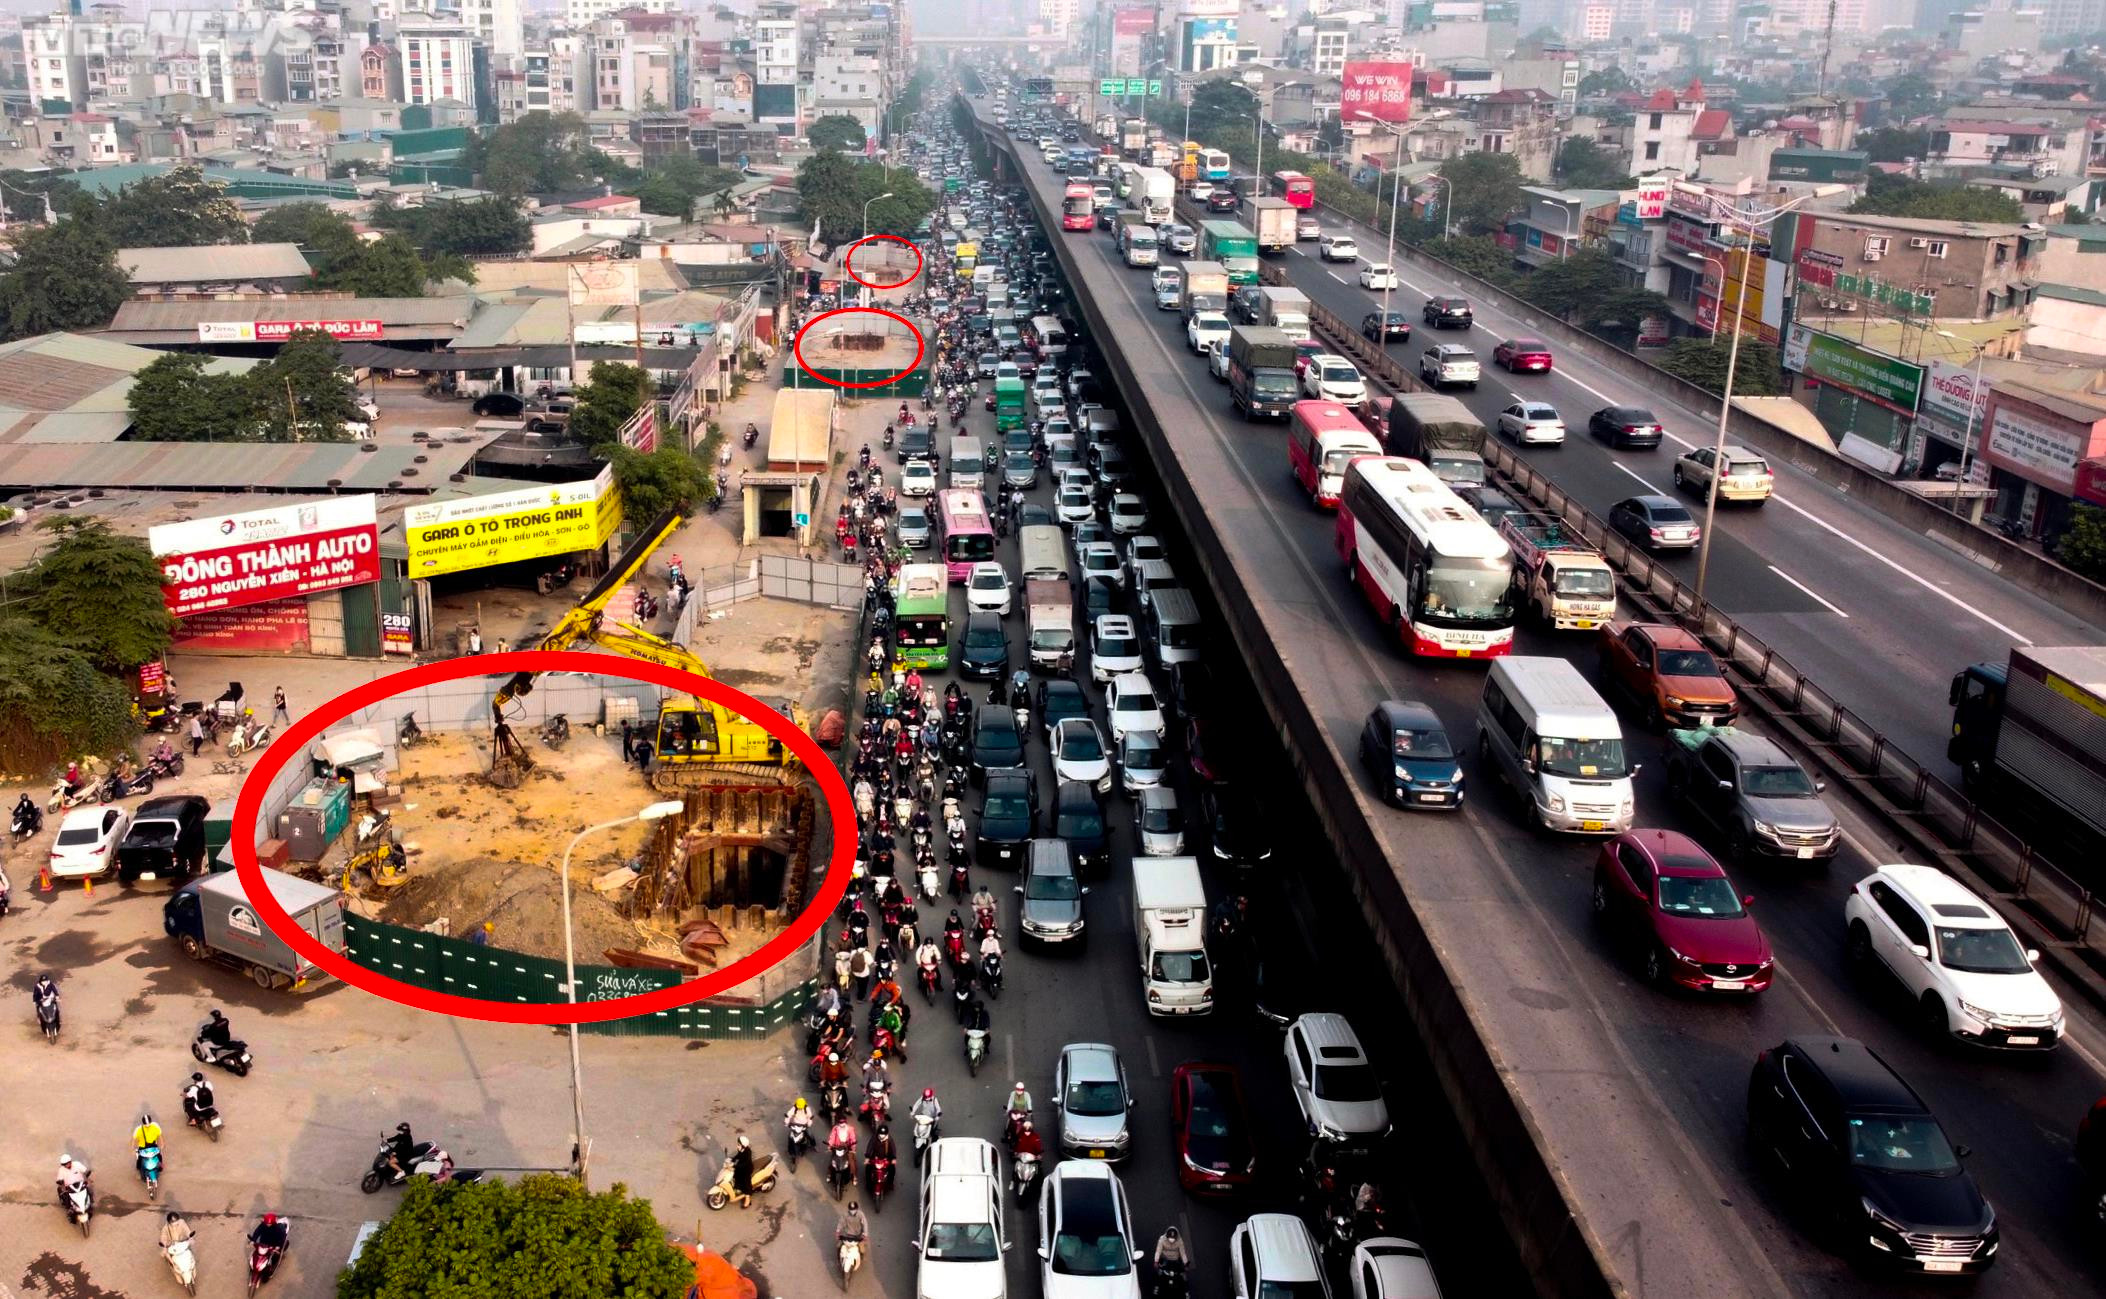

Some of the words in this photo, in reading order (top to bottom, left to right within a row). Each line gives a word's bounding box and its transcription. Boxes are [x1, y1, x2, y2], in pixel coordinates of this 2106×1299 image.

[1354, 75, 1374, 85] WE
[1375, 75, 1398, 85] WIN
[1344, 89, 1361, 102] 096
[1364, 90, 1380, 102] 184
[1640, 206, 1662, 216] LAN
[258, 324, 290, 334] GARA
[241, 518, 280, 529] TOTAL
[422, 528, 460, 542] GARA
[464, 519, 476, 536] Ô
[480, 518, 500, 534] TÔ
[504, 512, 551, 530] TRỌNG
[555, 507, 584, 520] ANH
[416, 544, 448, 557] CHUYÊN
[450, 540, 468, 552] MÁY
[490, 534, 508, 547] ĐIỆN
[533, 528, 550, 538] HÒA
[237, 543, 311, 574] THÀNH
[316, 533, 372, 558] AUTO
[310, 562, 330, 578] HÀ
[332, 558, 354, 576] NỘI
[384, 614, 410, 626] 280
[294, 827, 300, 836] 2
